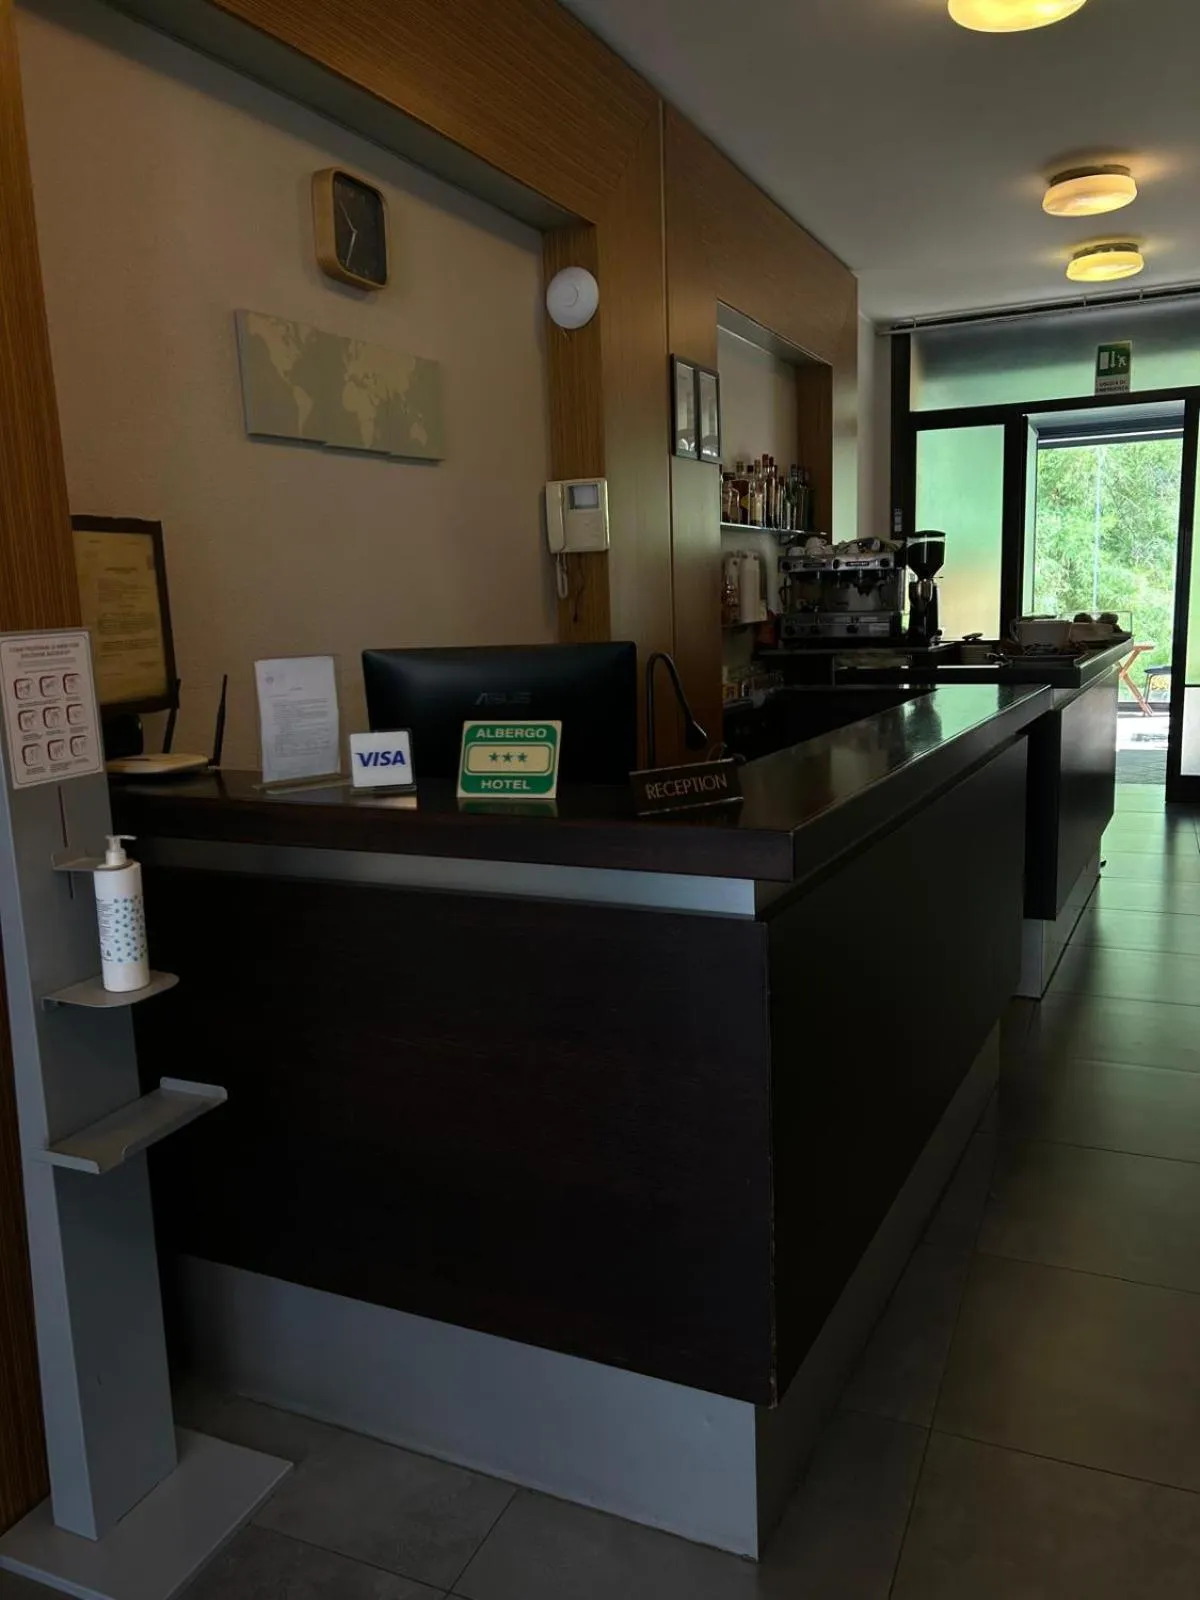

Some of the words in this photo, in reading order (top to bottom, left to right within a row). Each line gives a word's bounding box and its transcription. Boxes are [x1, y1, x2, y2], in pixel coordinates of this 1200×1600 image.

[475, 727, 548, 740] ALBERGO
[354, 750, 406, 767] VISA
[480, 779, 531, 791] HOTEL
[644, 773, 728, 800] RECEPTION
